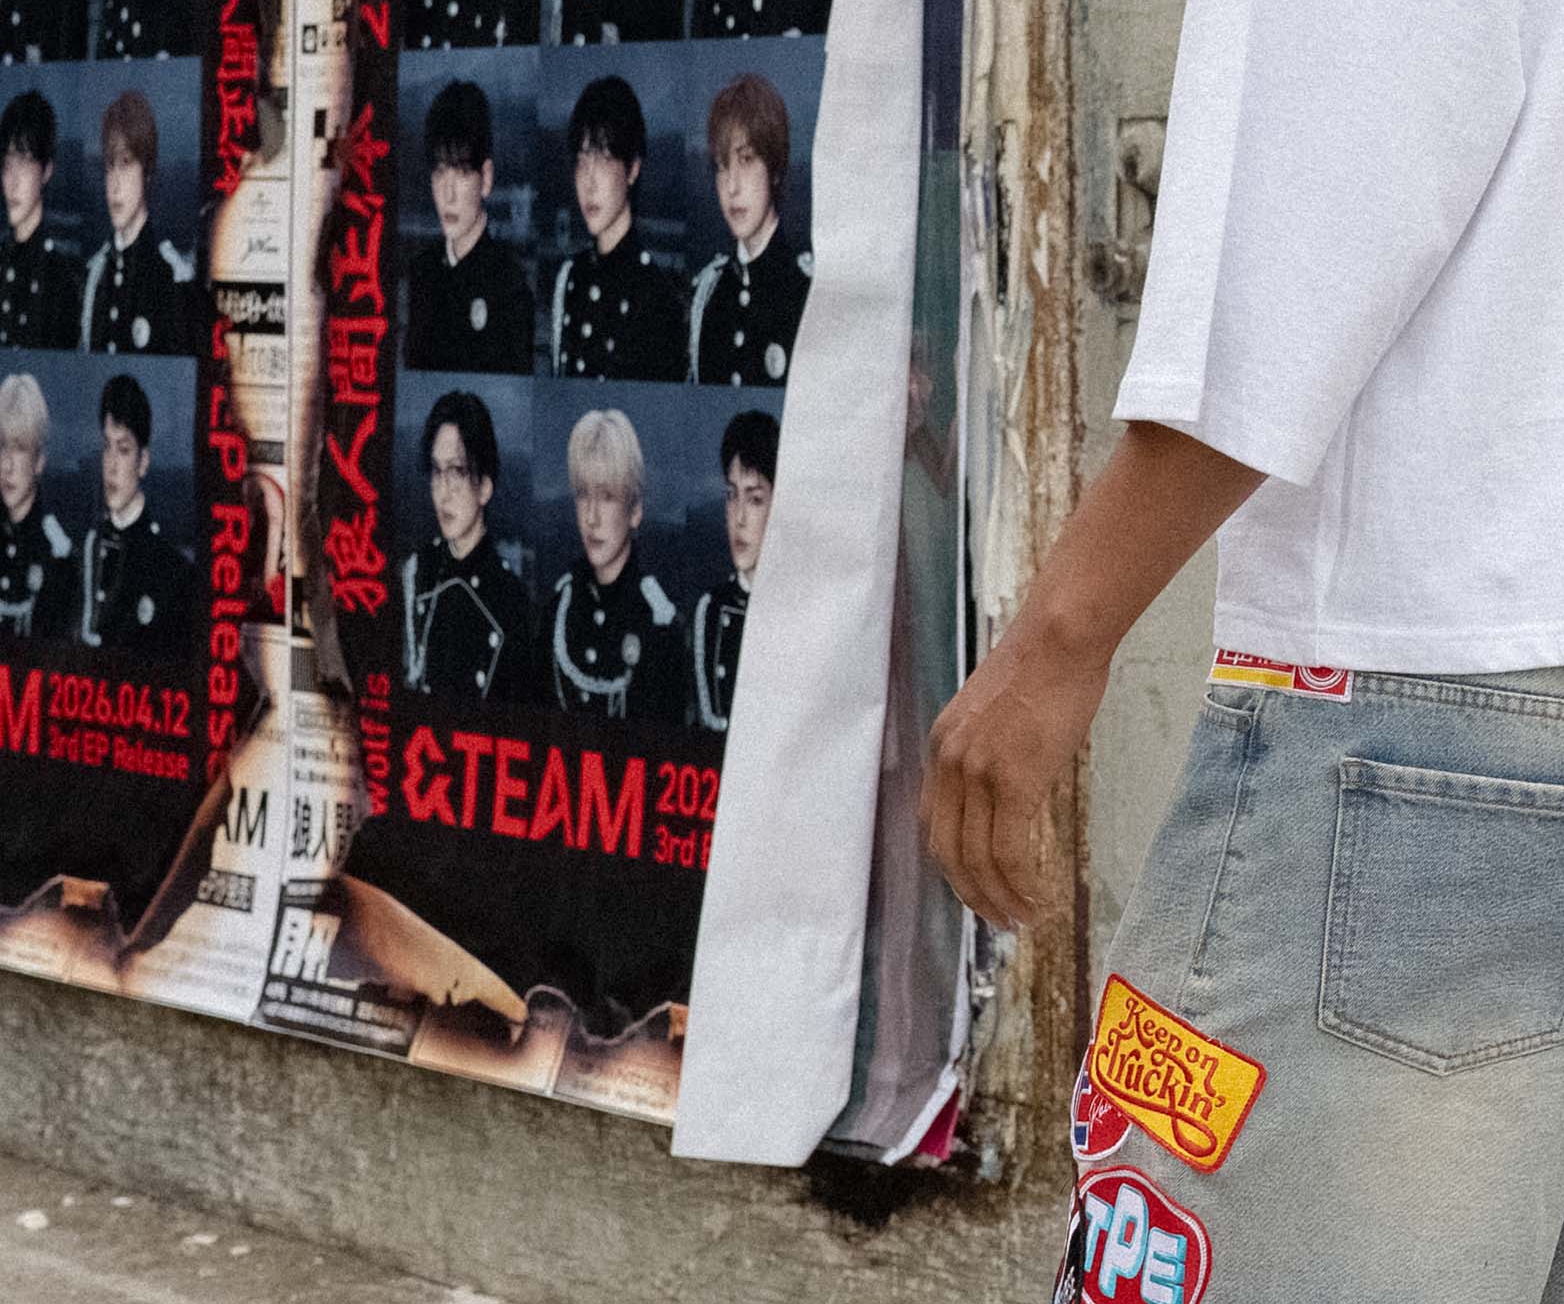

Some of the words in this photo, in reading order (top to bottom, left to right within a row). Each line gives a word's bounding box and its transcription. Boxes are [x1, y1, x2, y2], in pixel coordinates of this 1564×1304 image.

[49, 671, 191, 738] 2026.04.12
[50, 723, 80, 762] 3rd
[82, 730, 110, 766] EP
[112, 734, 191, 782] Release
[402, 724, 647, 858] &TEAM
[654, 823, 697, 868] 3rd
[1118, 997, 1186, 1067] Keep
[1185, 1047, 1220, 1097] on
[1096, 1028, 1226, 1157] Truckin'
